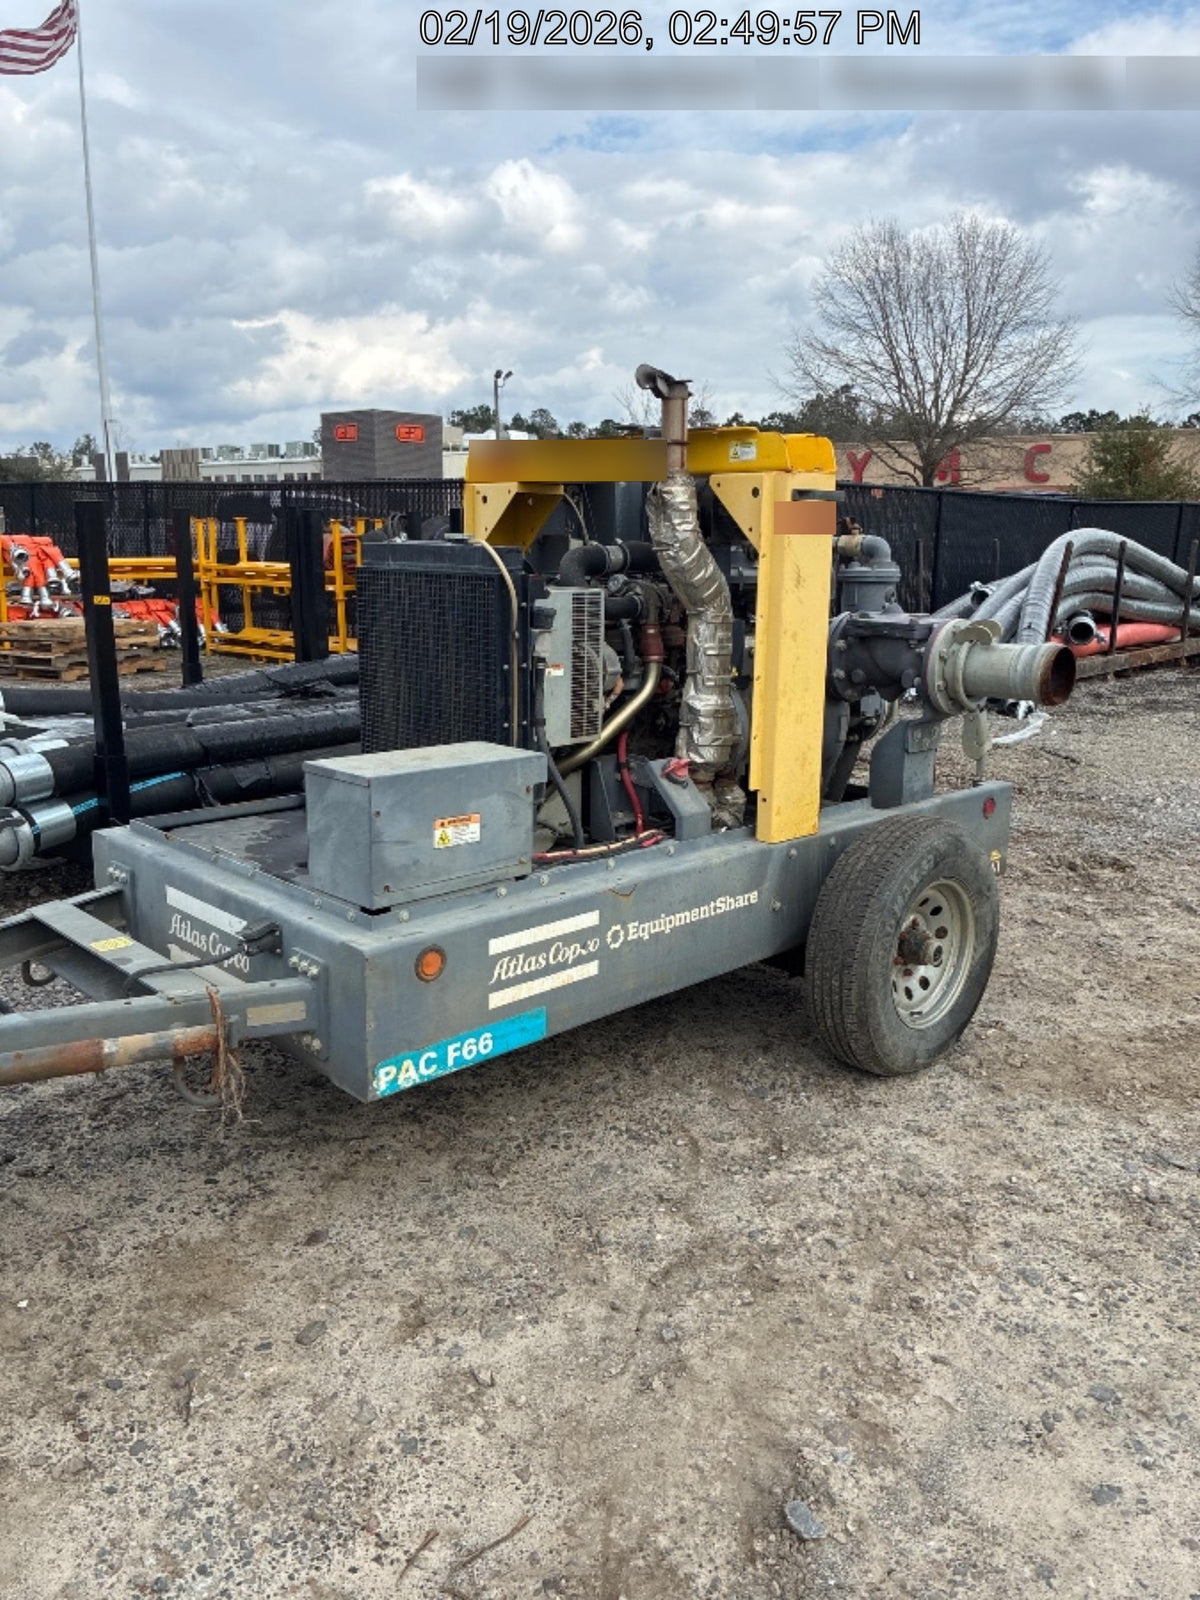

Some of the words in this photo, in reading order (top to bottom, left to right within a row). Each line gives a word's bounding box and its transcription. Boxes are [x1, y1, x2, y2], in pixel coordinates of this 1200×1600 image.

[168, 913, 207, 951] Atlas
[626, 889, 759, 941] EquipmentShare
[489, 951, 547, 985] Atlas
[548, 937, 600, 966] Copco
[374, 1051, 438, 1092] PAC
[447, 1031, 494, 1067] F66
